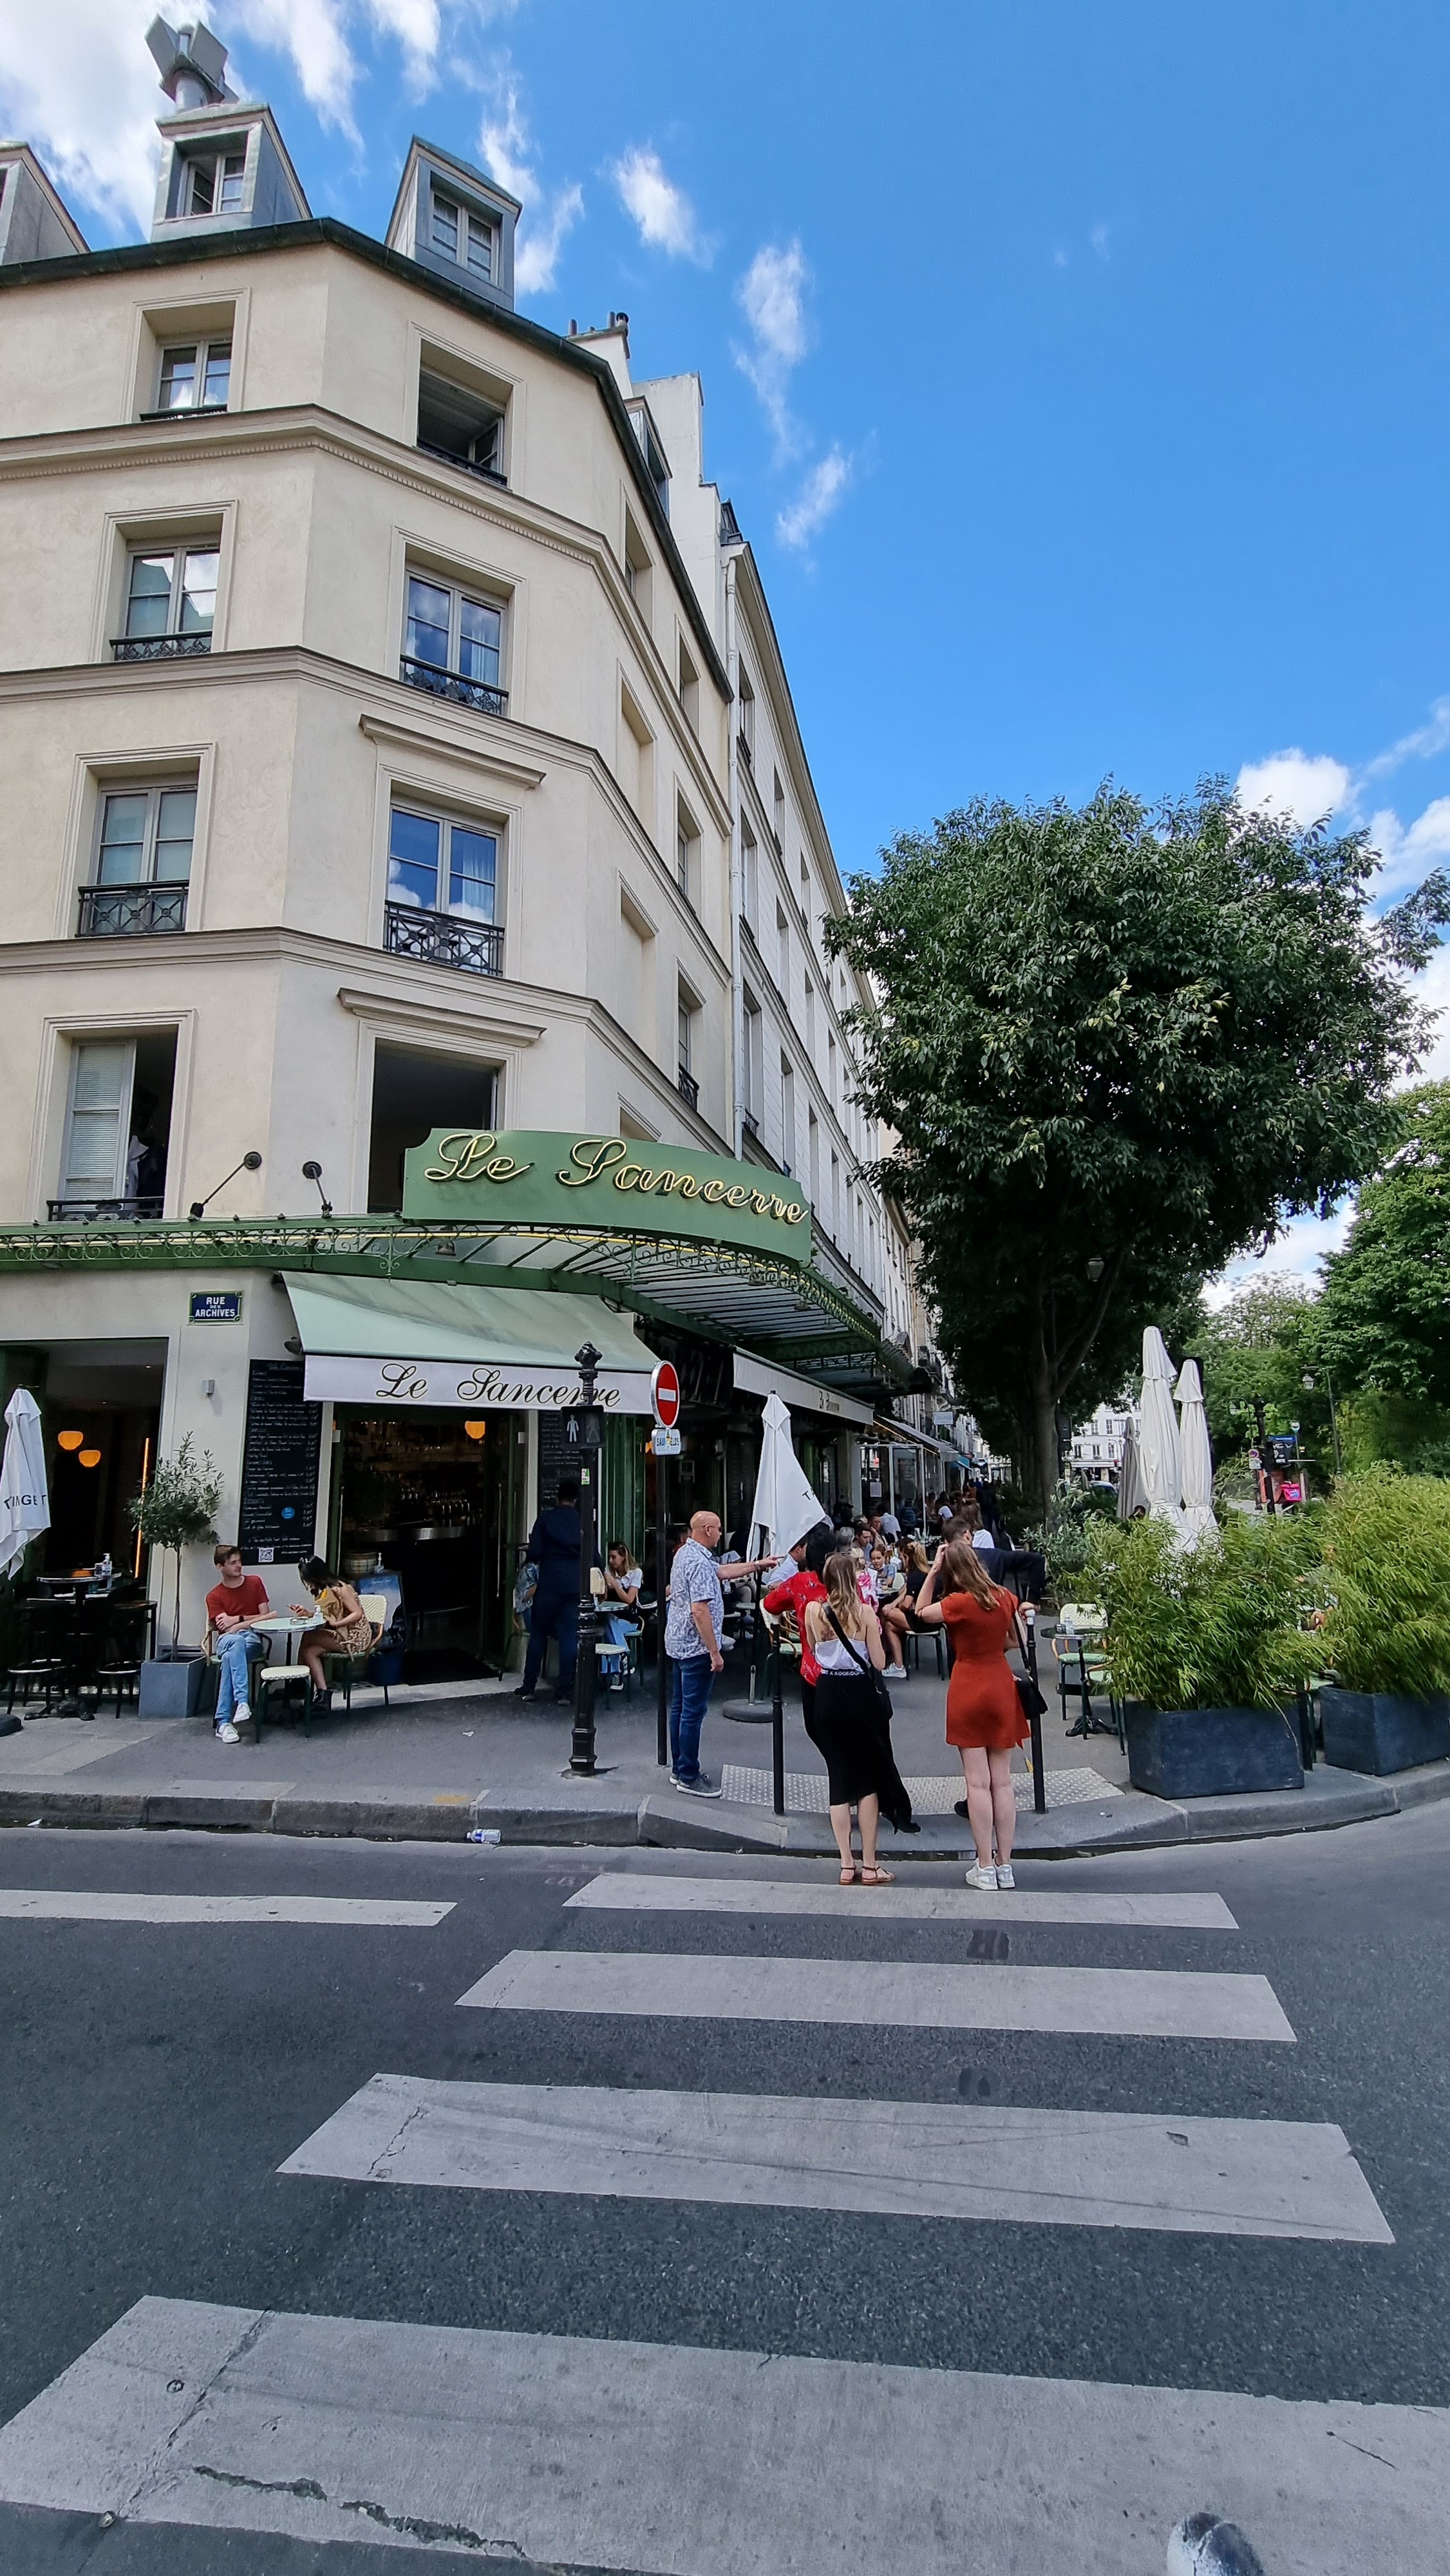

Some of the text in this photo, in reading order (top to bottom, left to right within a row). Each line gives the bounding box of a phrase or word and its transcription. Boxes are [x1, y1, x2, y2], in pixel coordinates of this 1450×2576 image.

[424, 1133, 809, 1224] Le Sancerre
[206, 1296, 225, 1305] RUE
[195, 1309, 236, 1318] ARCHIVES
[375, 1363, 428, 1399] Le
